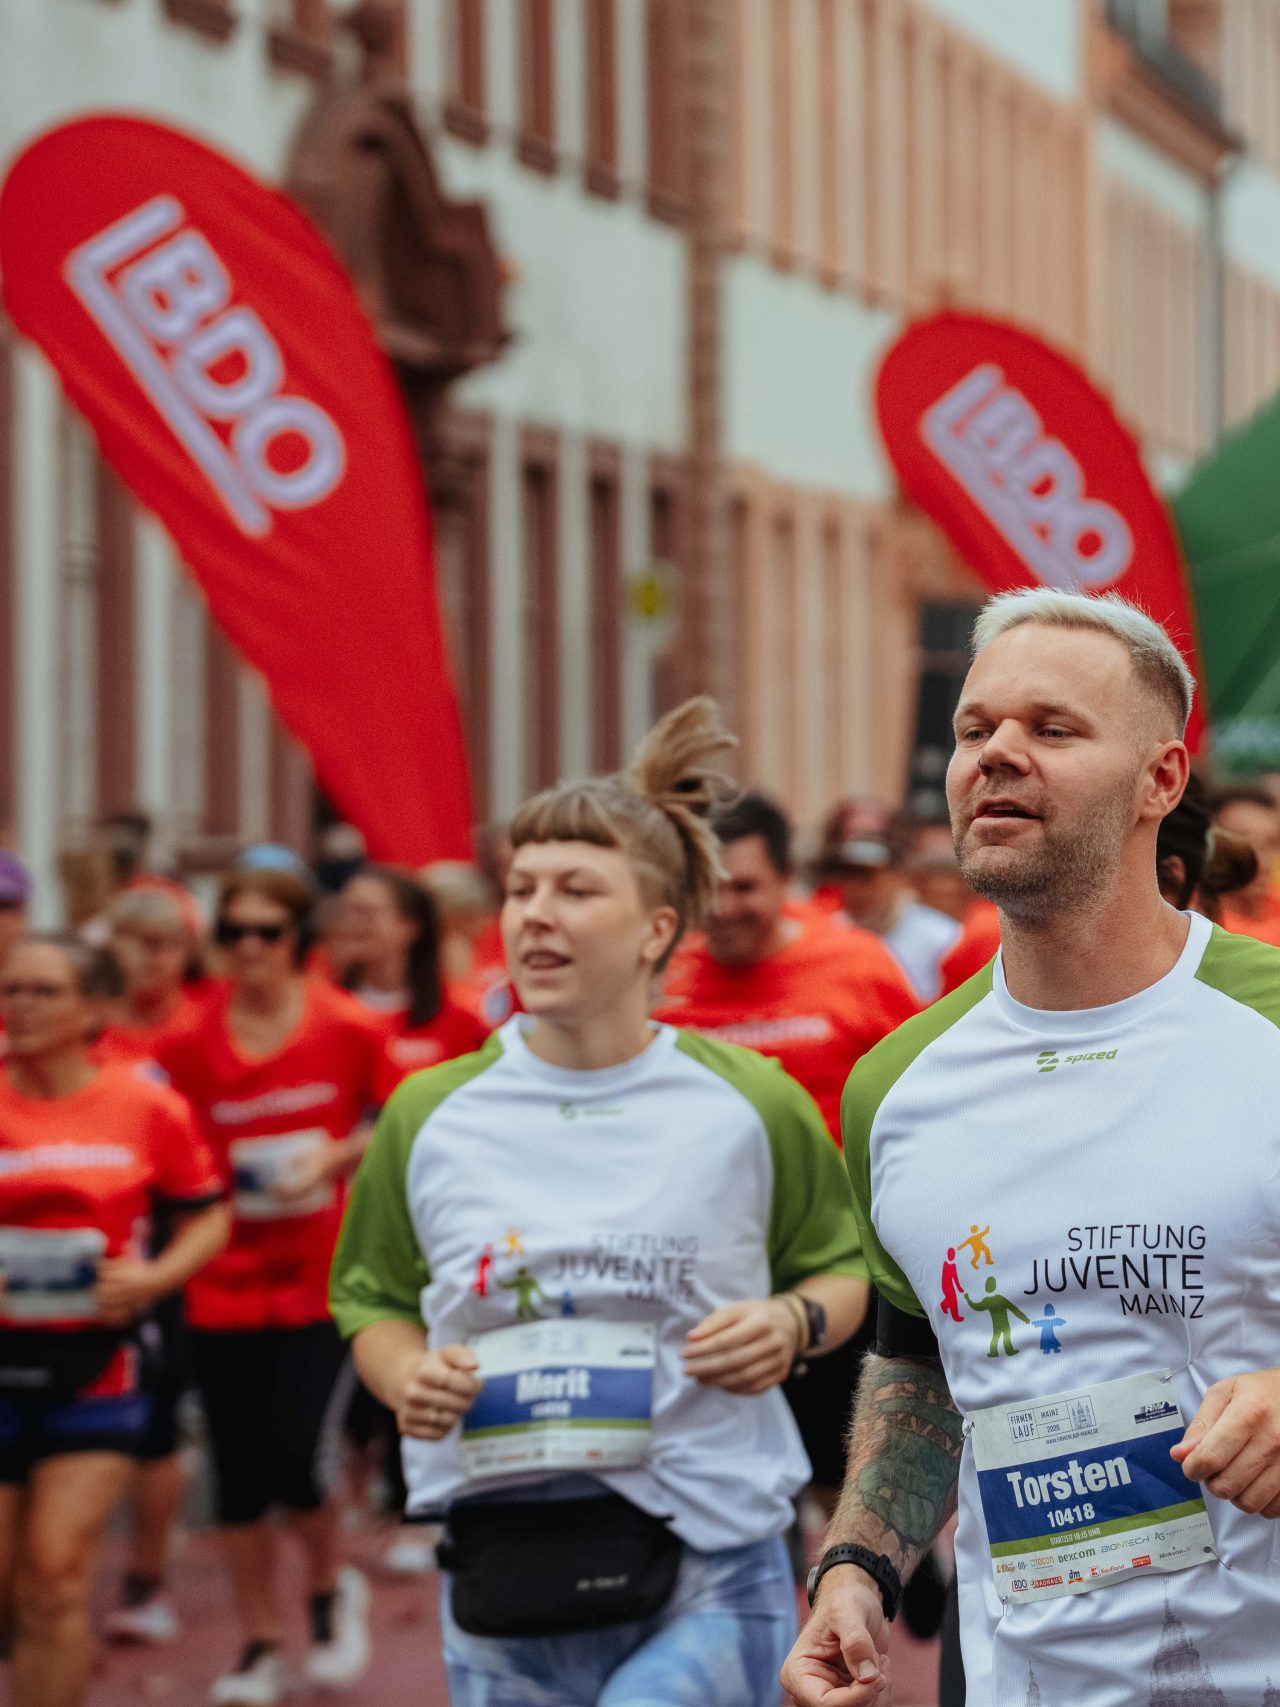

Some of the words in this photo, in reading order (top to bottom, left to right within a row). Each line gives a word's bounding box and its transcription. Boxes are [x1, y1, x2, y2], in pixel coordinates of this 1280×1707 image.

[117, 226, 347, 511] BDO
[955, 388, 1135, 590] BDO
[1063, 1048, 1119, 1064] spized
[590, 1232, 699, 1254] STIFTUNG
[1067, 1224, 1207, 1252] STIFTUNG
[552, 1253, 697, 1283] JUVENTE
[1023, 1253, 1206, 1296] JUVENTE
[1119, 1293, 1206, 1320] MAINZ
[1010, 1412, 1033, 1425] FIRMEN
[1040, 1408, 1060, 1418] MAINZ
[1012, 1423, 1035, 1439] LAUF
[1006, 1456, 1132, 1508] Torsten
[1046, 1502, 1096, 1528] 10418
[1100, 1535, 1150, 1553] BIONTECH
[1013, 1579, 1028, 1589] BDO
[1034, 1575, 1063, 1588] BAUHAUS
[1068, 1569, 1081, 1580] dm
[1101, 1564, 1125, 1574] Kaufland
